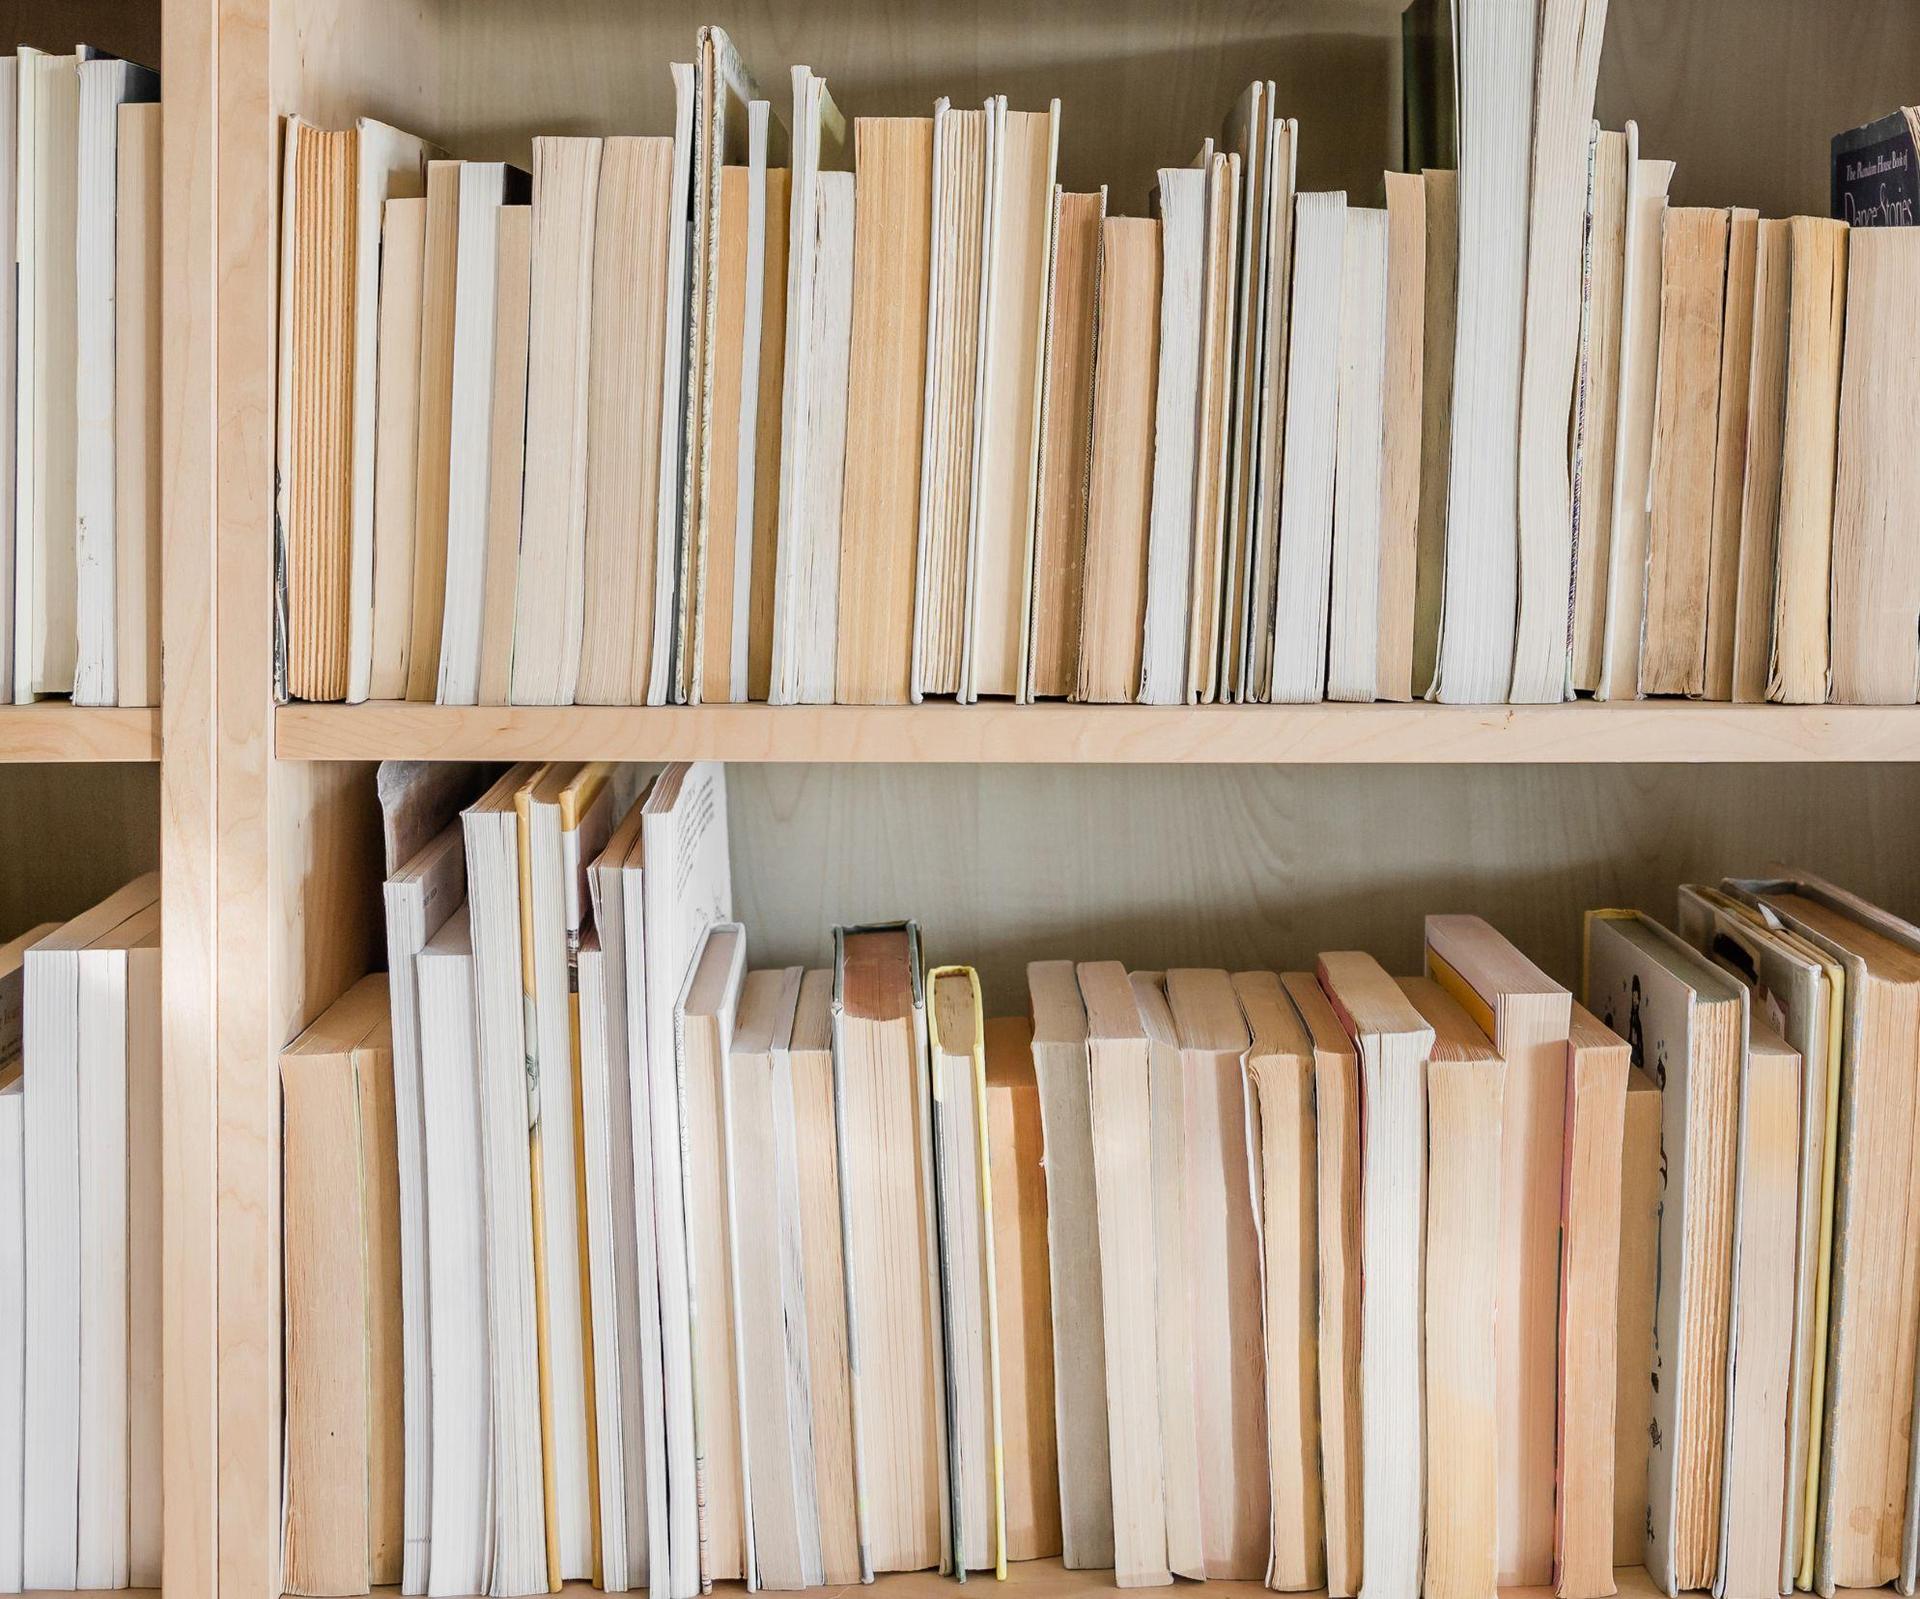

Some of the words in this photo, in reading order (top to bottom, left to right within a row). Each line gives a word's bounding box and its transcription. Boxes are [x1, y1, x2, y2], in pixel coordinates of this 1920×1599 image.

[1846, 165, 1856, 181] The
[1857, 161, 1877, 179] Random
[1877, 155, 1892, 174] House
[1892, 150, 1903, 169] Book
[1903, 148, 1908, 172] of
[1844, 192, 1877, 227] Dance
[1880, 182, 1913, 227] Stories
